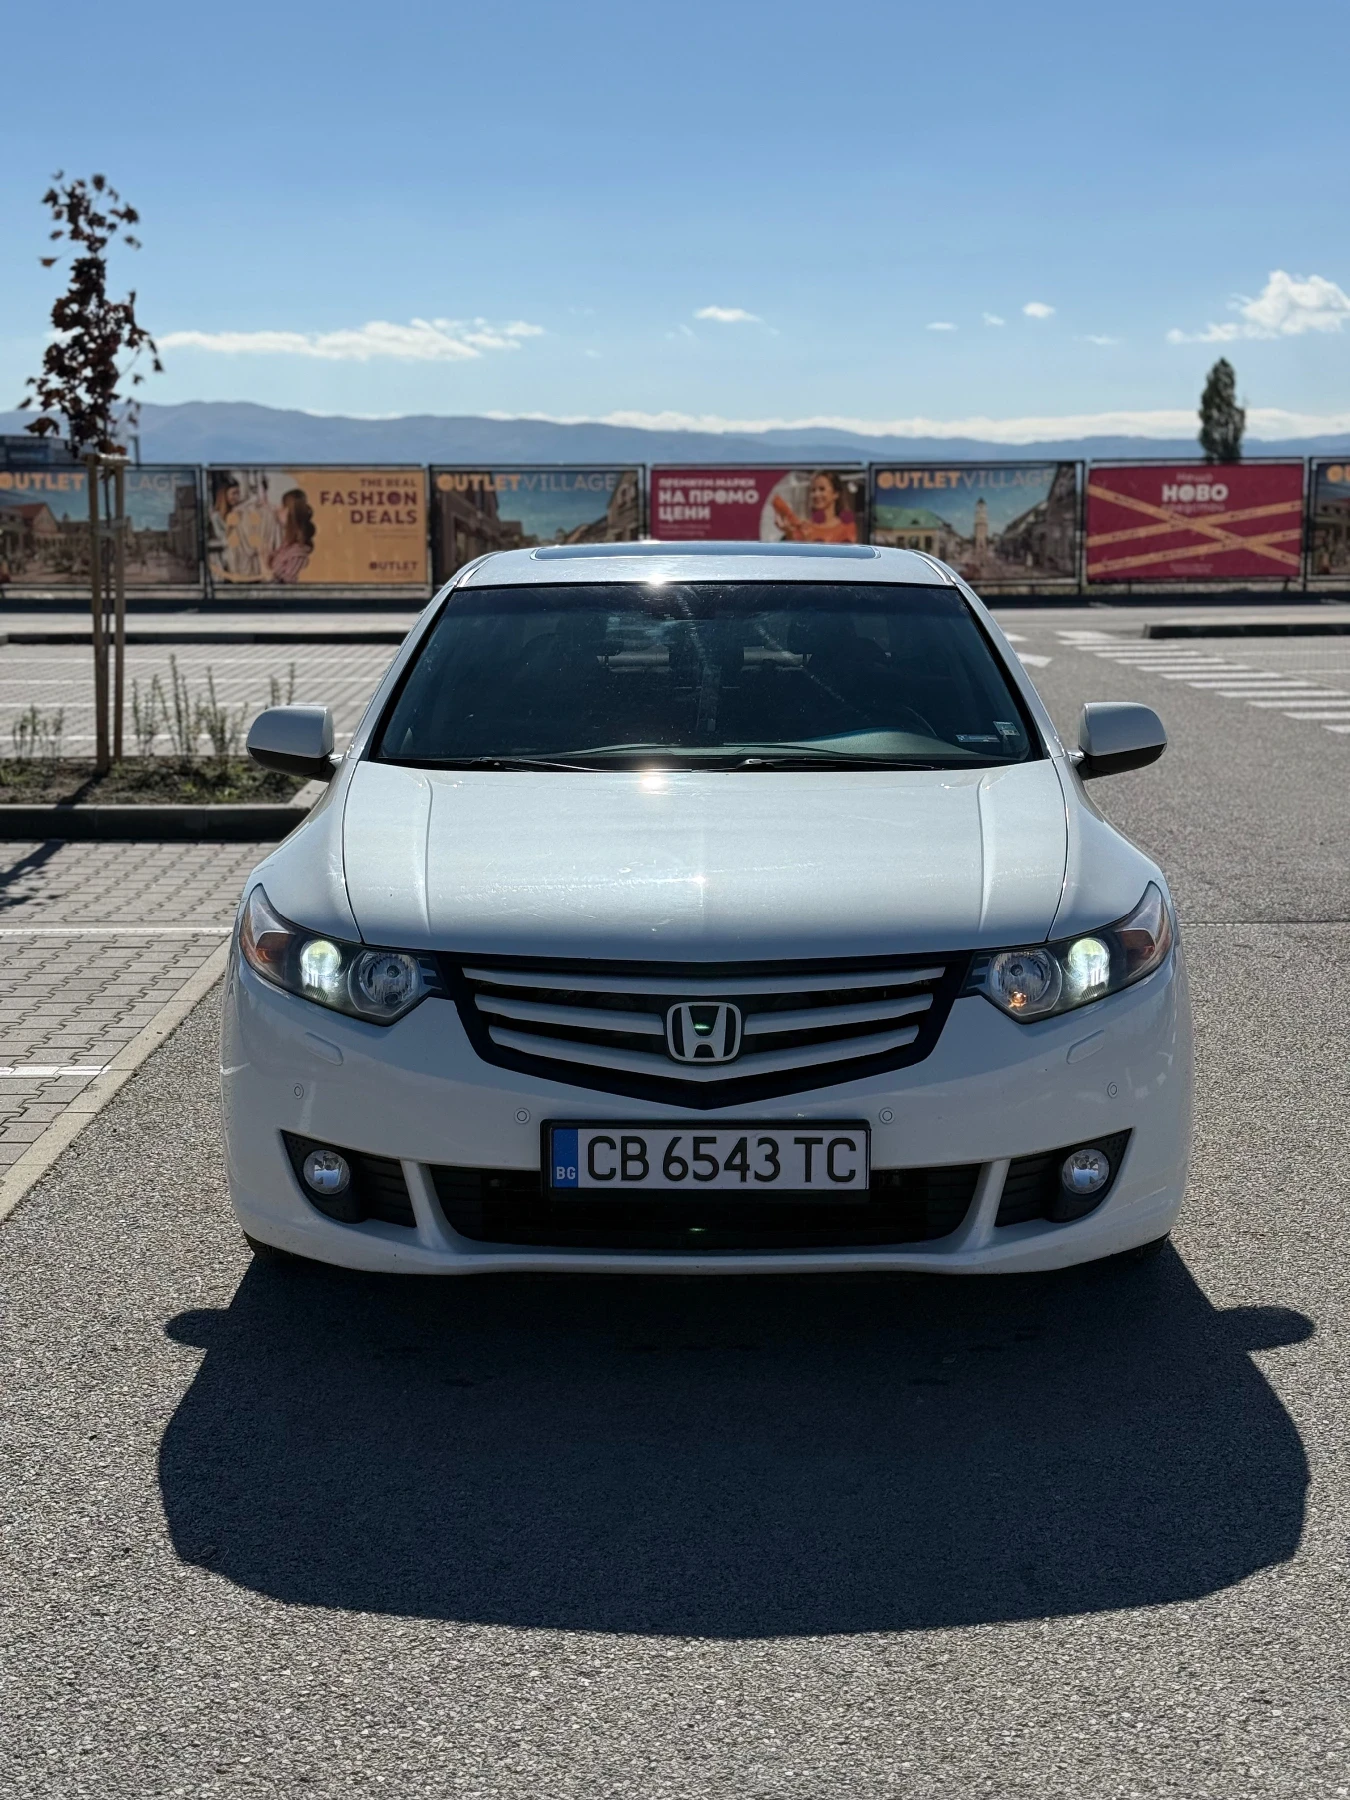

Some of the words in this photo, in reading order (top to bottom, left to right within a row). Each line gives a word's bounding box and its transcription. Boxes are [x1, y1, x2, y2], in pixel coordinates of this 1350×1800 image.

[360, 478, 382, 487] THE
[385, 478, 416, 487] REAL
[320, 491, 417, 505] FASHION
[658, 489, 686, 504] НА
[689, 489, 759, 504] ПРОМО
[1162, 483, 1230, 502] НОВО
[350, 510, 417, 525] DEALS
[658, 505, 711, 522] ЦЕНИ
[369, 561, 418, 571] OUTLET
[587, 1135, 650, 1181] CB
[662, 1136, 781, 1182] 6543
[794, 1137, 857, 1182] TC
[556, 1166, 576, 1180] BG
